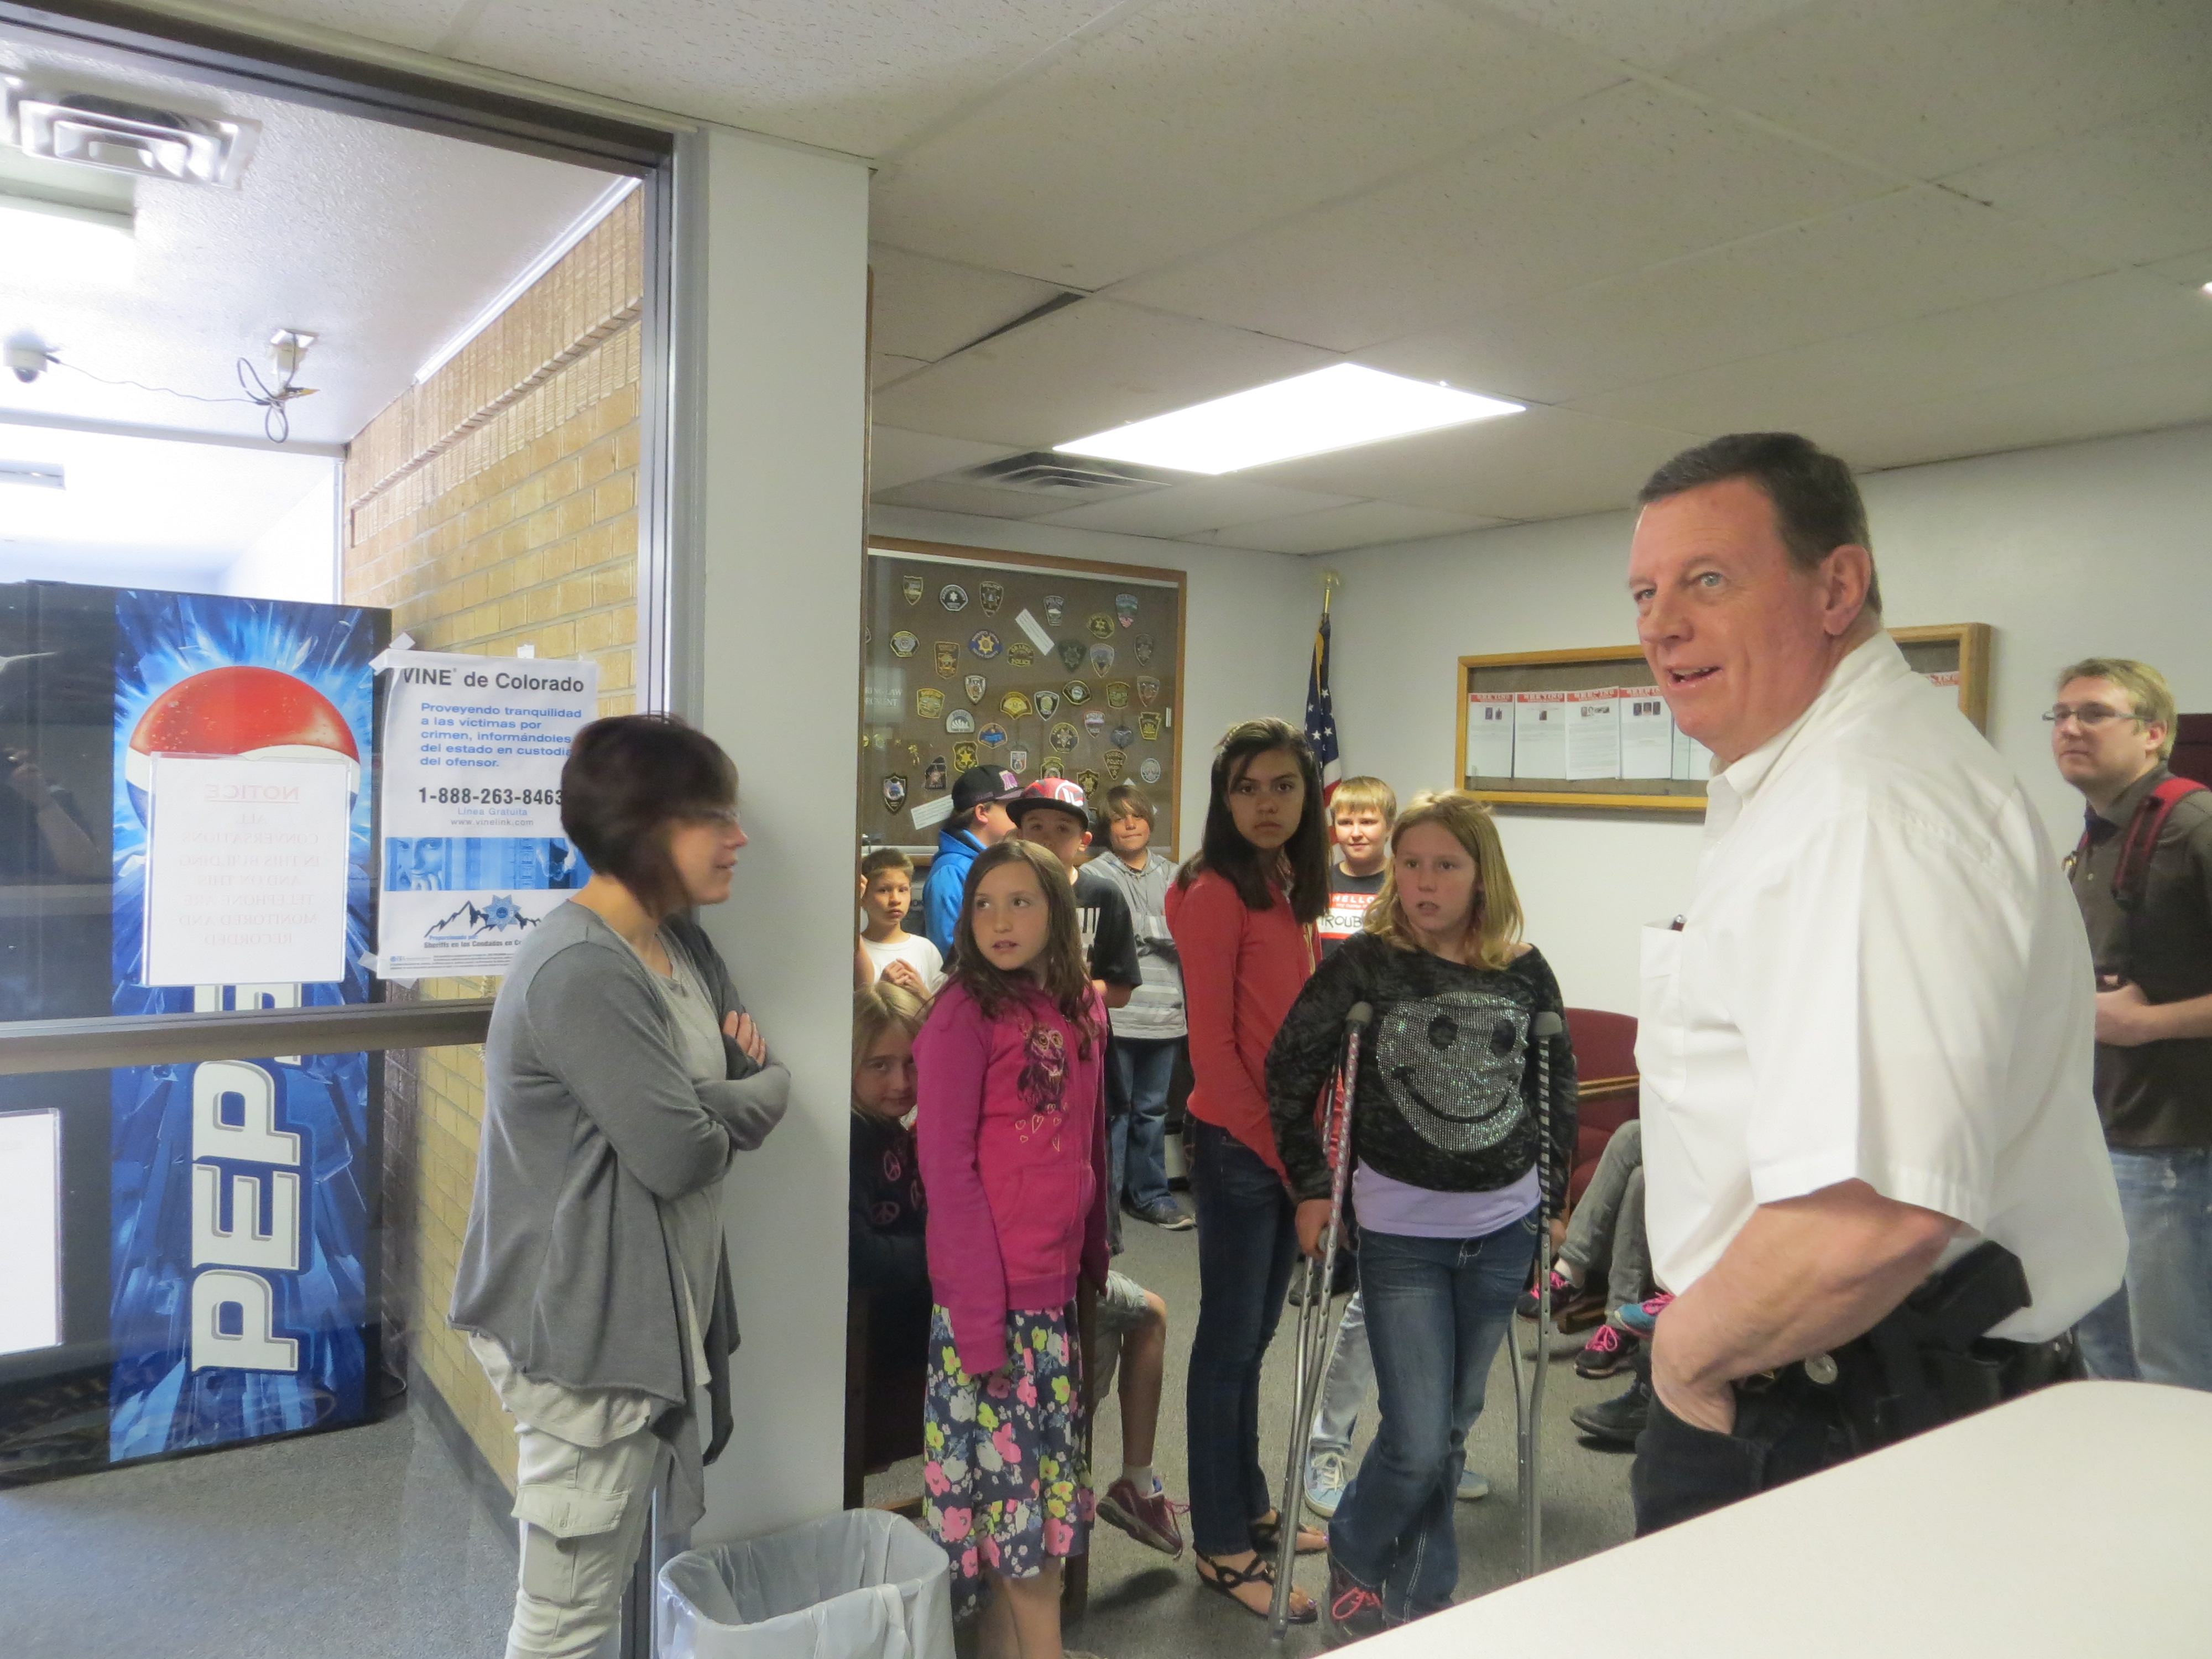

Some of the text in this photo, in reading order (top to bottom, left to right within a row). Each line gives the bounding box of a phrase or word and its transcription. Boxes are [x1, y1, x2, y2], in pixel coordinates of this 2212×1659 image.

[464, 671, 488, 687] de
[495, 673, 584, 692] Colorado
[421, 703, 582, 718] Proveyendo tranquilidad
[435, 717, 455, 726] las
[520, 721, 541, 730] por
[421, 731, 572, 743] crimen, informándoles
[420, 744, 441, 753] del
[446, 744, 493, 754] estado
[517, 747, 571, 757] custodia
[420, 757, 499, 768] del ofensor.
[419, 787, 562, 805] 1-888-263-8463
[458, 807, 528, 816] Línea Gratuita
[451, 817, 534, 827] www.vinelink.com
[1333, 895, 1375, 904] HELLO
[1319, 915, 1362, 928] TROUB
[192, 984, 301, 1372] PEP
